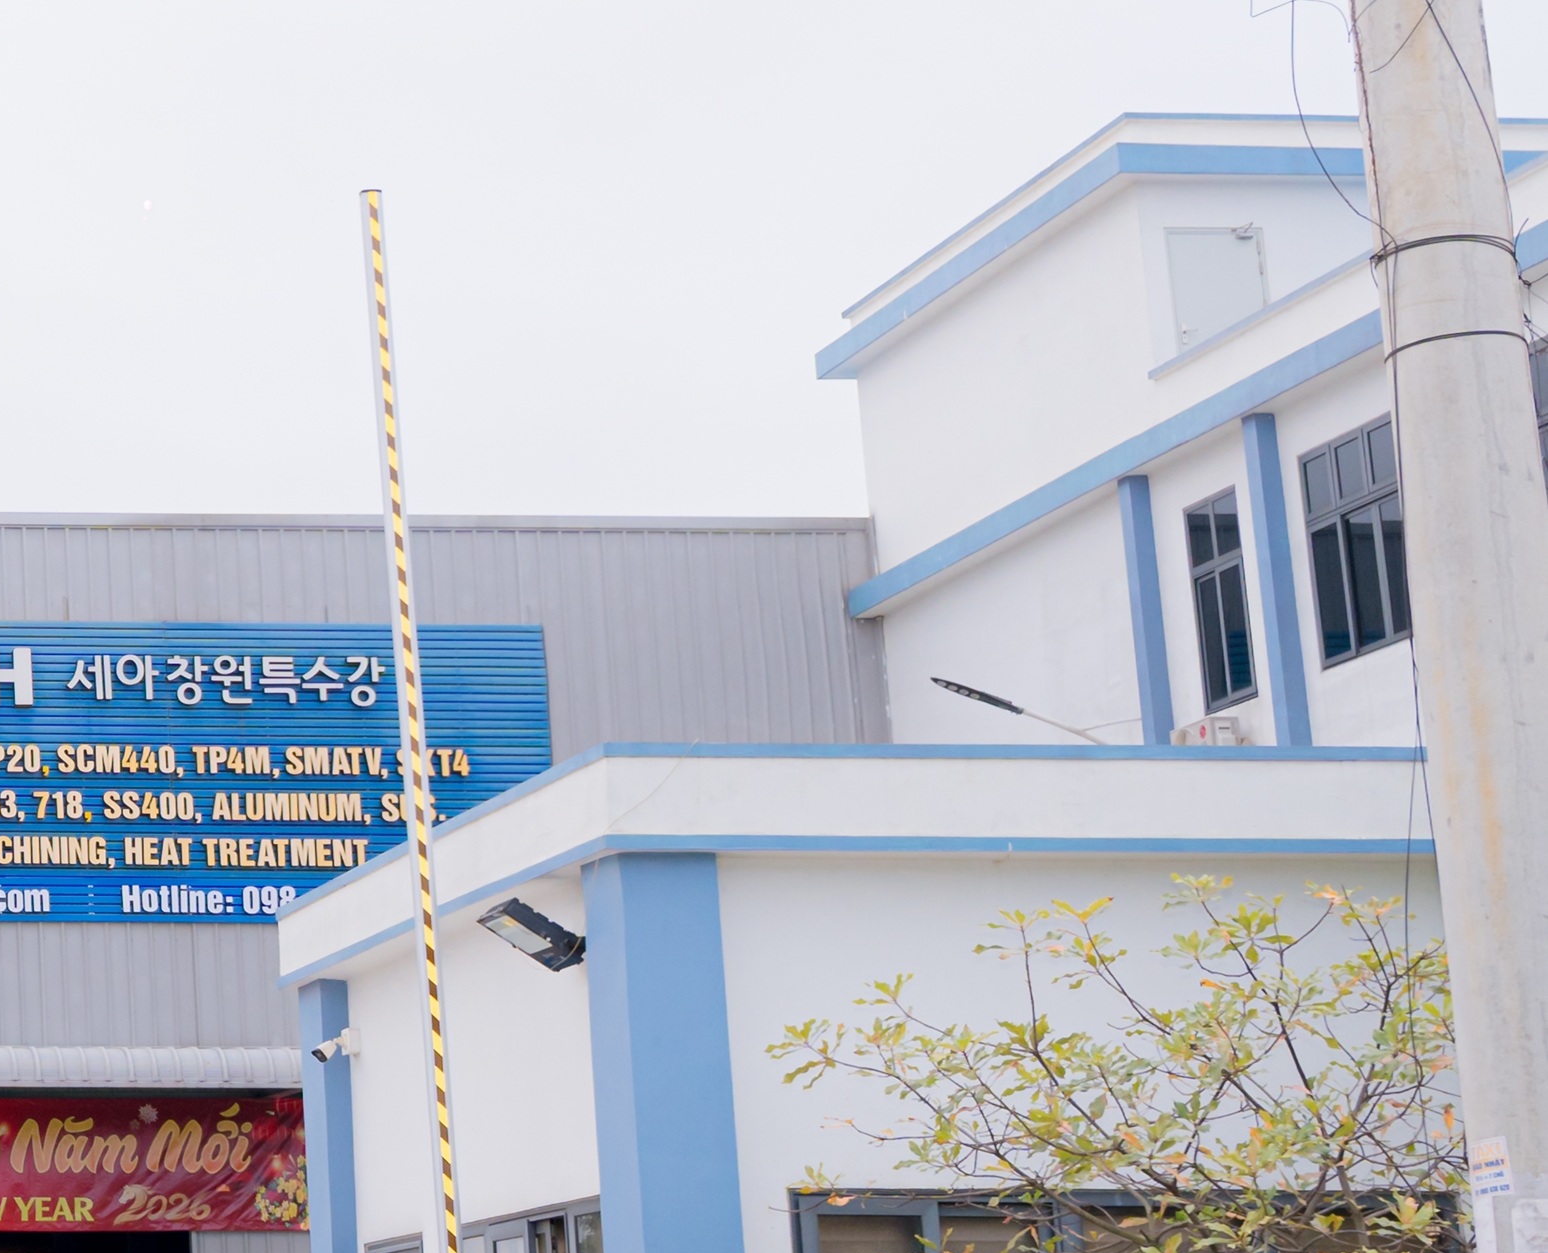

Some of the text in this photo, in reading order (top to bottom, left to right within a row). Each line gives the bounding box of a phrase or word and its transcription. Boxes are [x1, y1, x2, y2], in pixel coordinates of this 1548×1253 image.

[66, 654, 385, 707] 세아창원특수강
[57, 745, 184, 778] SCM440,
[192, 746, 280, 778] TP4M,
[286, 747, 388, 779] SMATV,
[33, 790, 93, 823] 718,
[103, 791, 202, 824] SS400,
[212, 792, 372, 825] ALUMINUM,
[124, 837, 193, 866] HEAT
[201, 838, 369, 868] TREATMENT
[121, 884, 234, 914] Hotline:
[10, 1115, 139, 1175] Năm
[146, 1103, 252, 1174] Mới
[13, 1196, 94, 1222] YEAR
[114, 1184, 212, 1226] 2026
